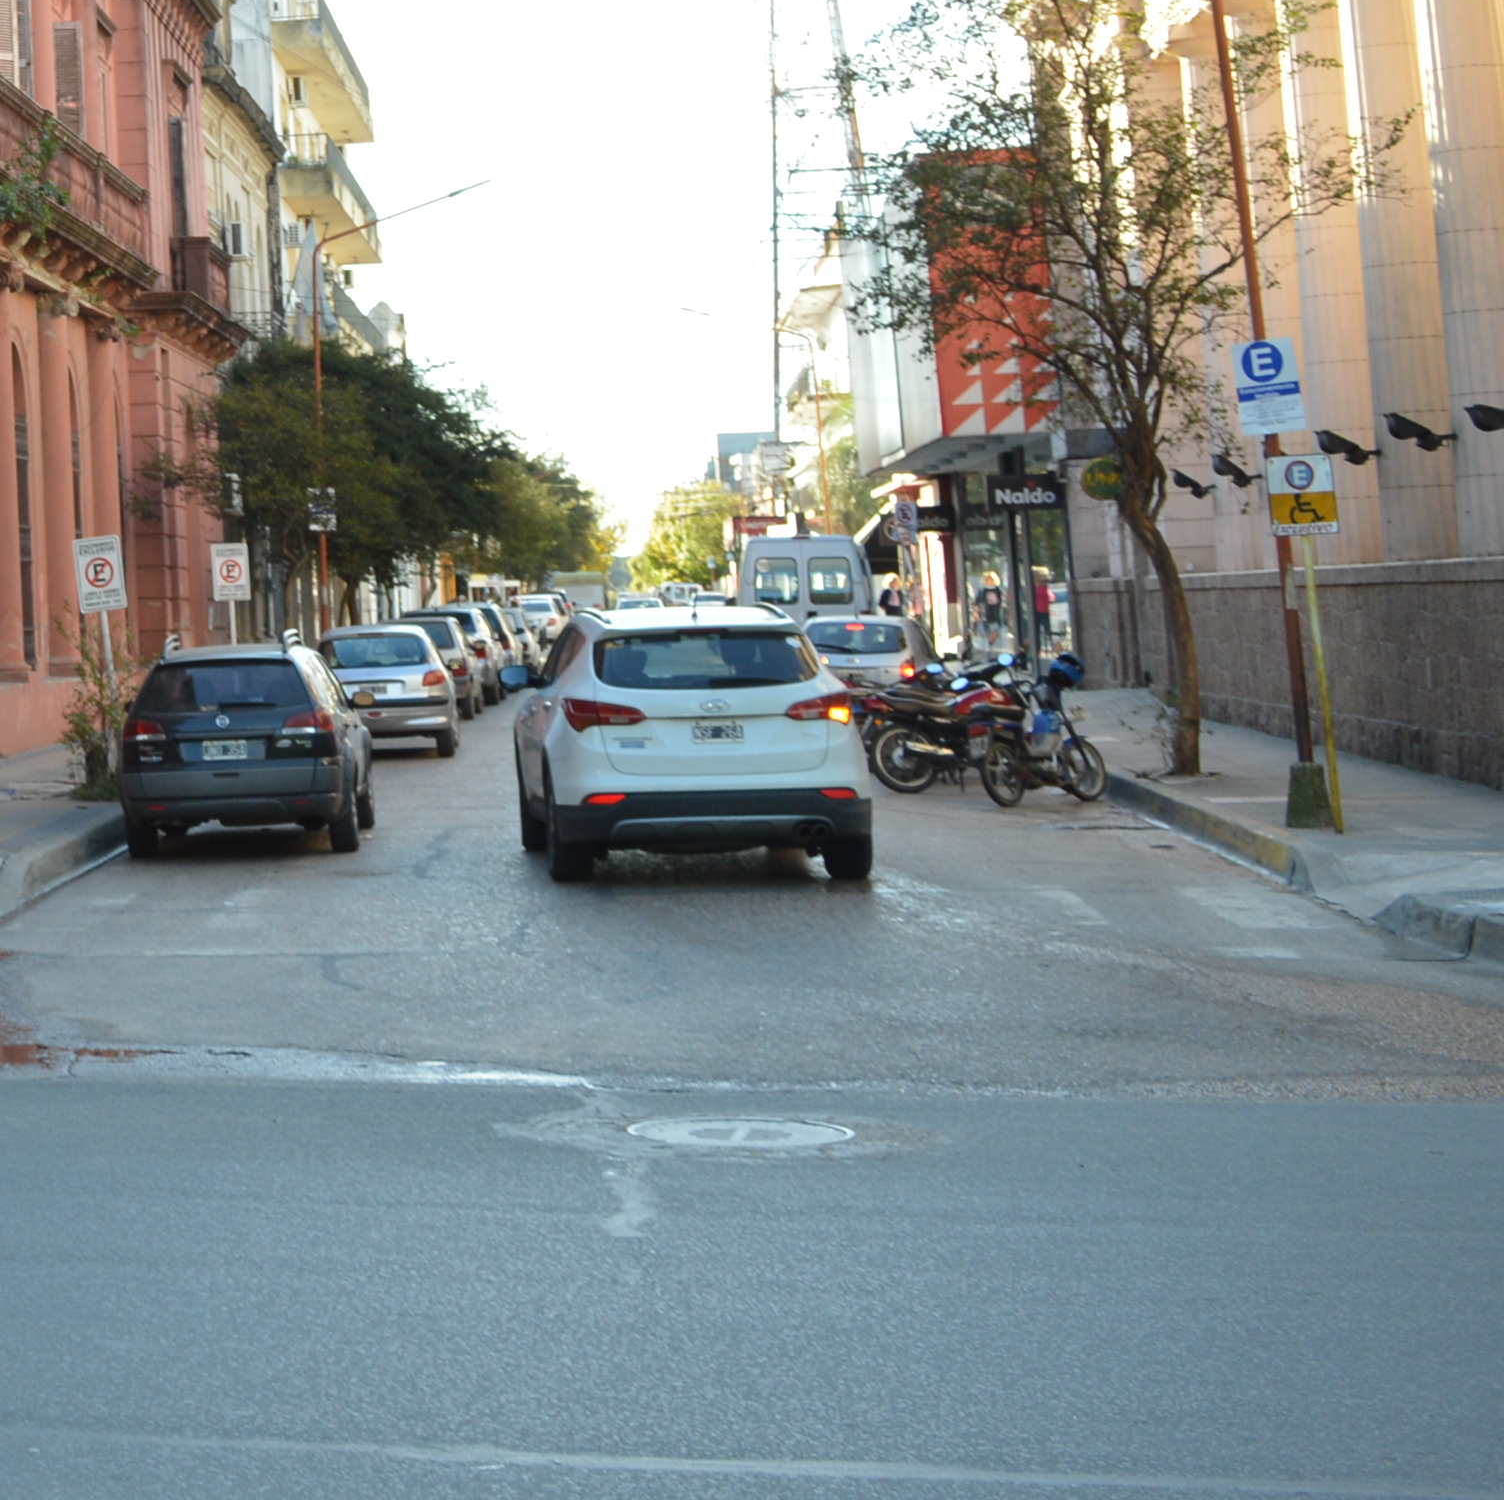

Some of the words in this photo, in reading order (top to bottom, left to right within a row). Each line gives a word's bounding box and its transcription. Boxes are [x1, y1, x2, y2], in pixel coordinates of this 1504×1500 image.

[1250, 346, 1277, 378] E
[995, 487, 1057, 505] Naldo
[78, 546, 116, 556] EXCLUSIVO
